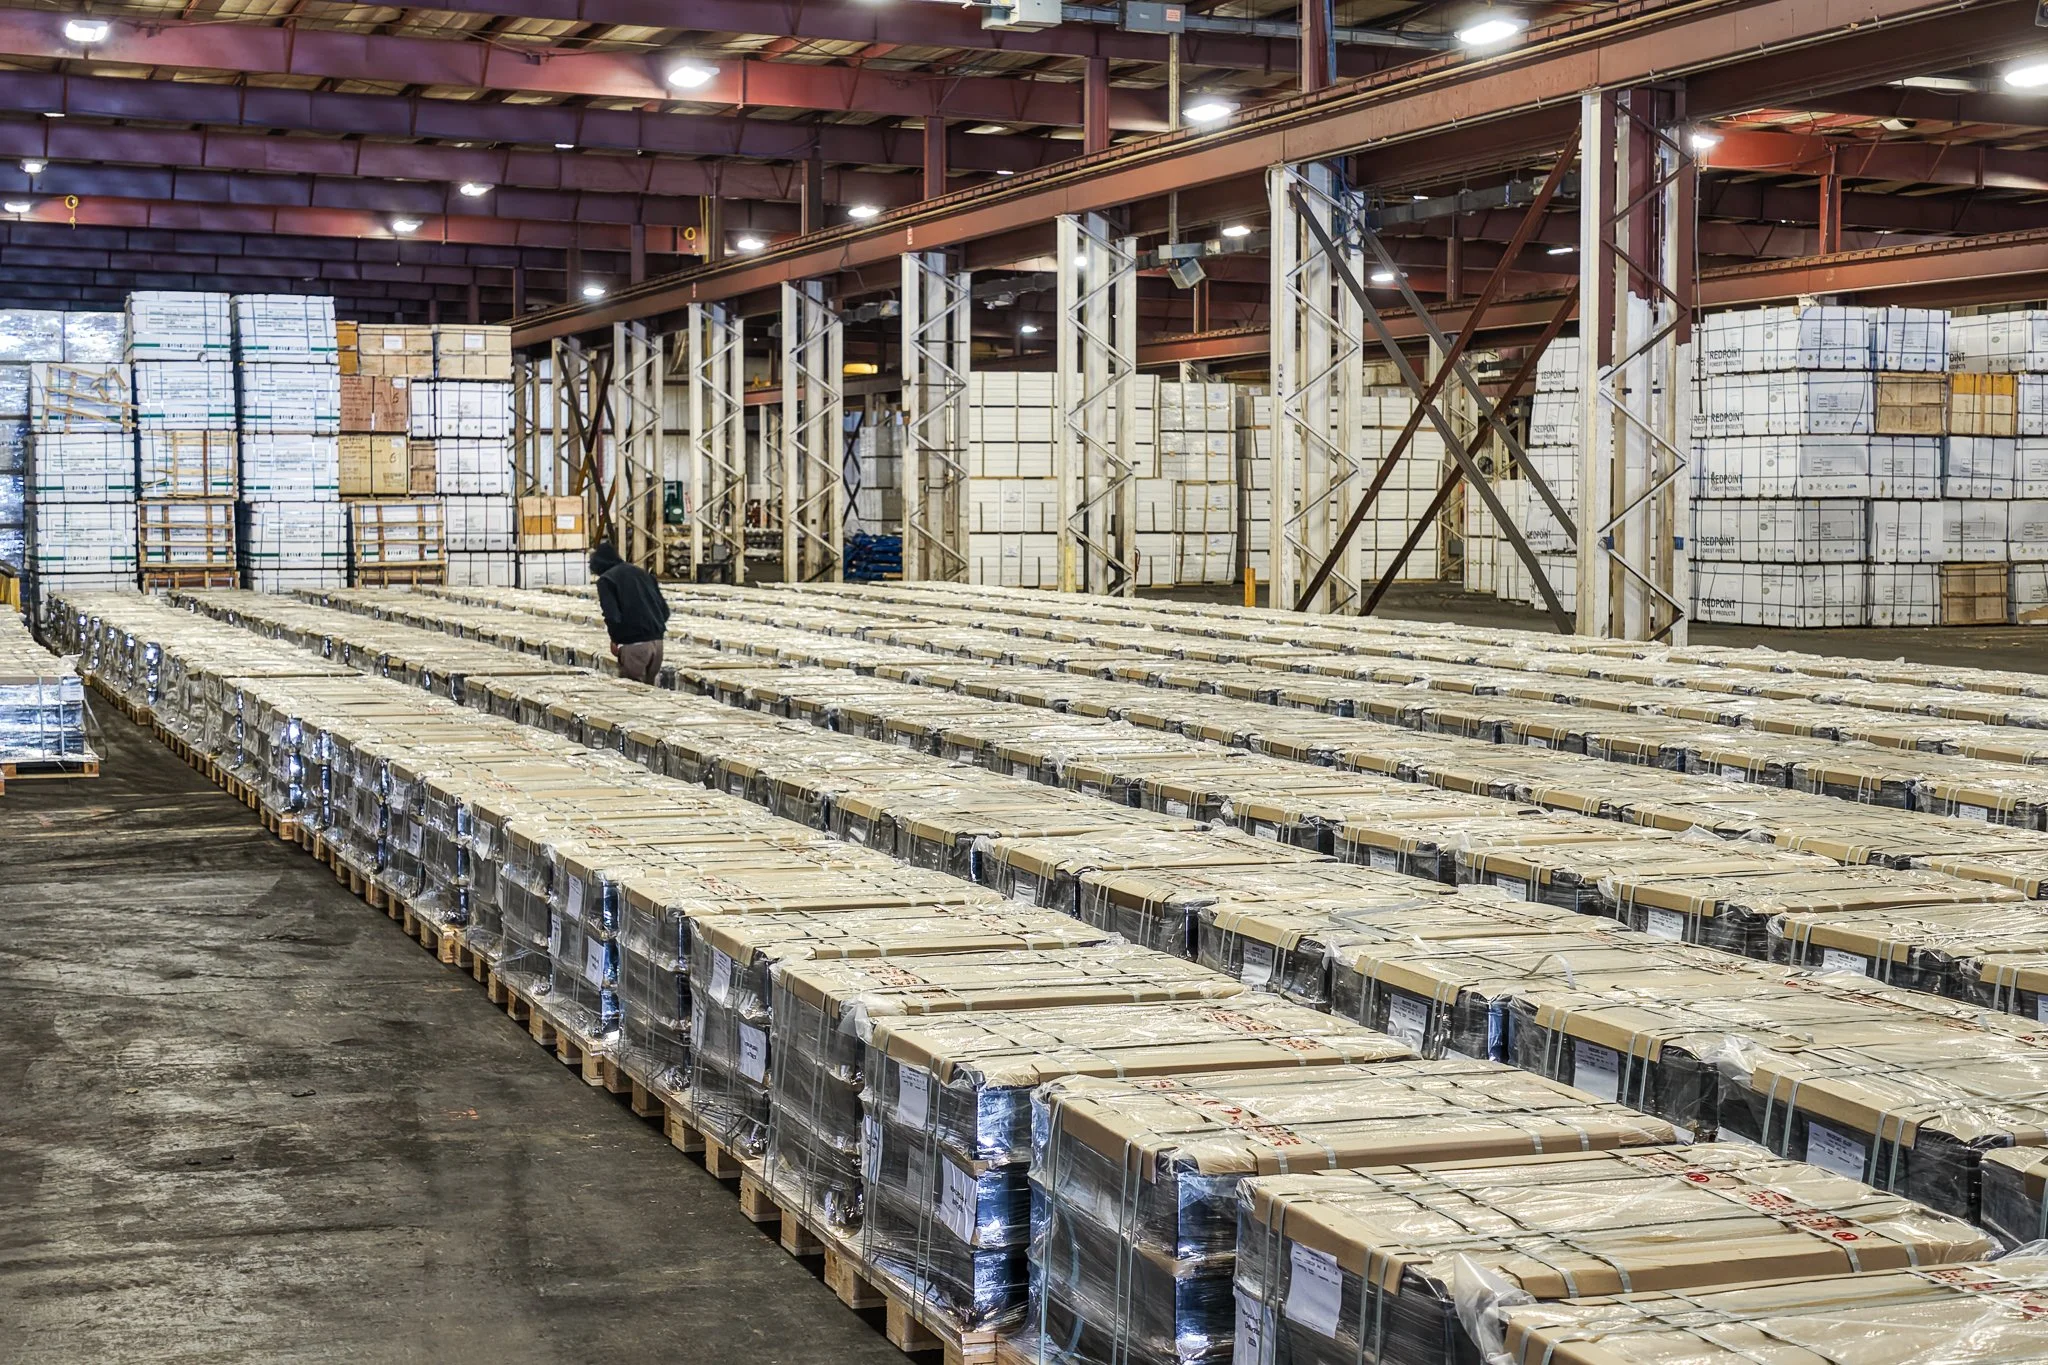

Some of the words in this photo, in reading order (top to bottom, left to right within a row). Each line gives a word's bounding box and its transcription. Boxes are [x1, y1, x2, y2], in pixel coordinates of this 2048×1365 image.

[1710, 348, 1742, 360] REDPOINT
[1711, 411, 1744, 423] REDPOINT
[1711, 473, 1743, 485] REDPOINT
[1701, 536, 1735, 547] REDPOINT
[1701, 597, 1736, 609] REDPOINT
